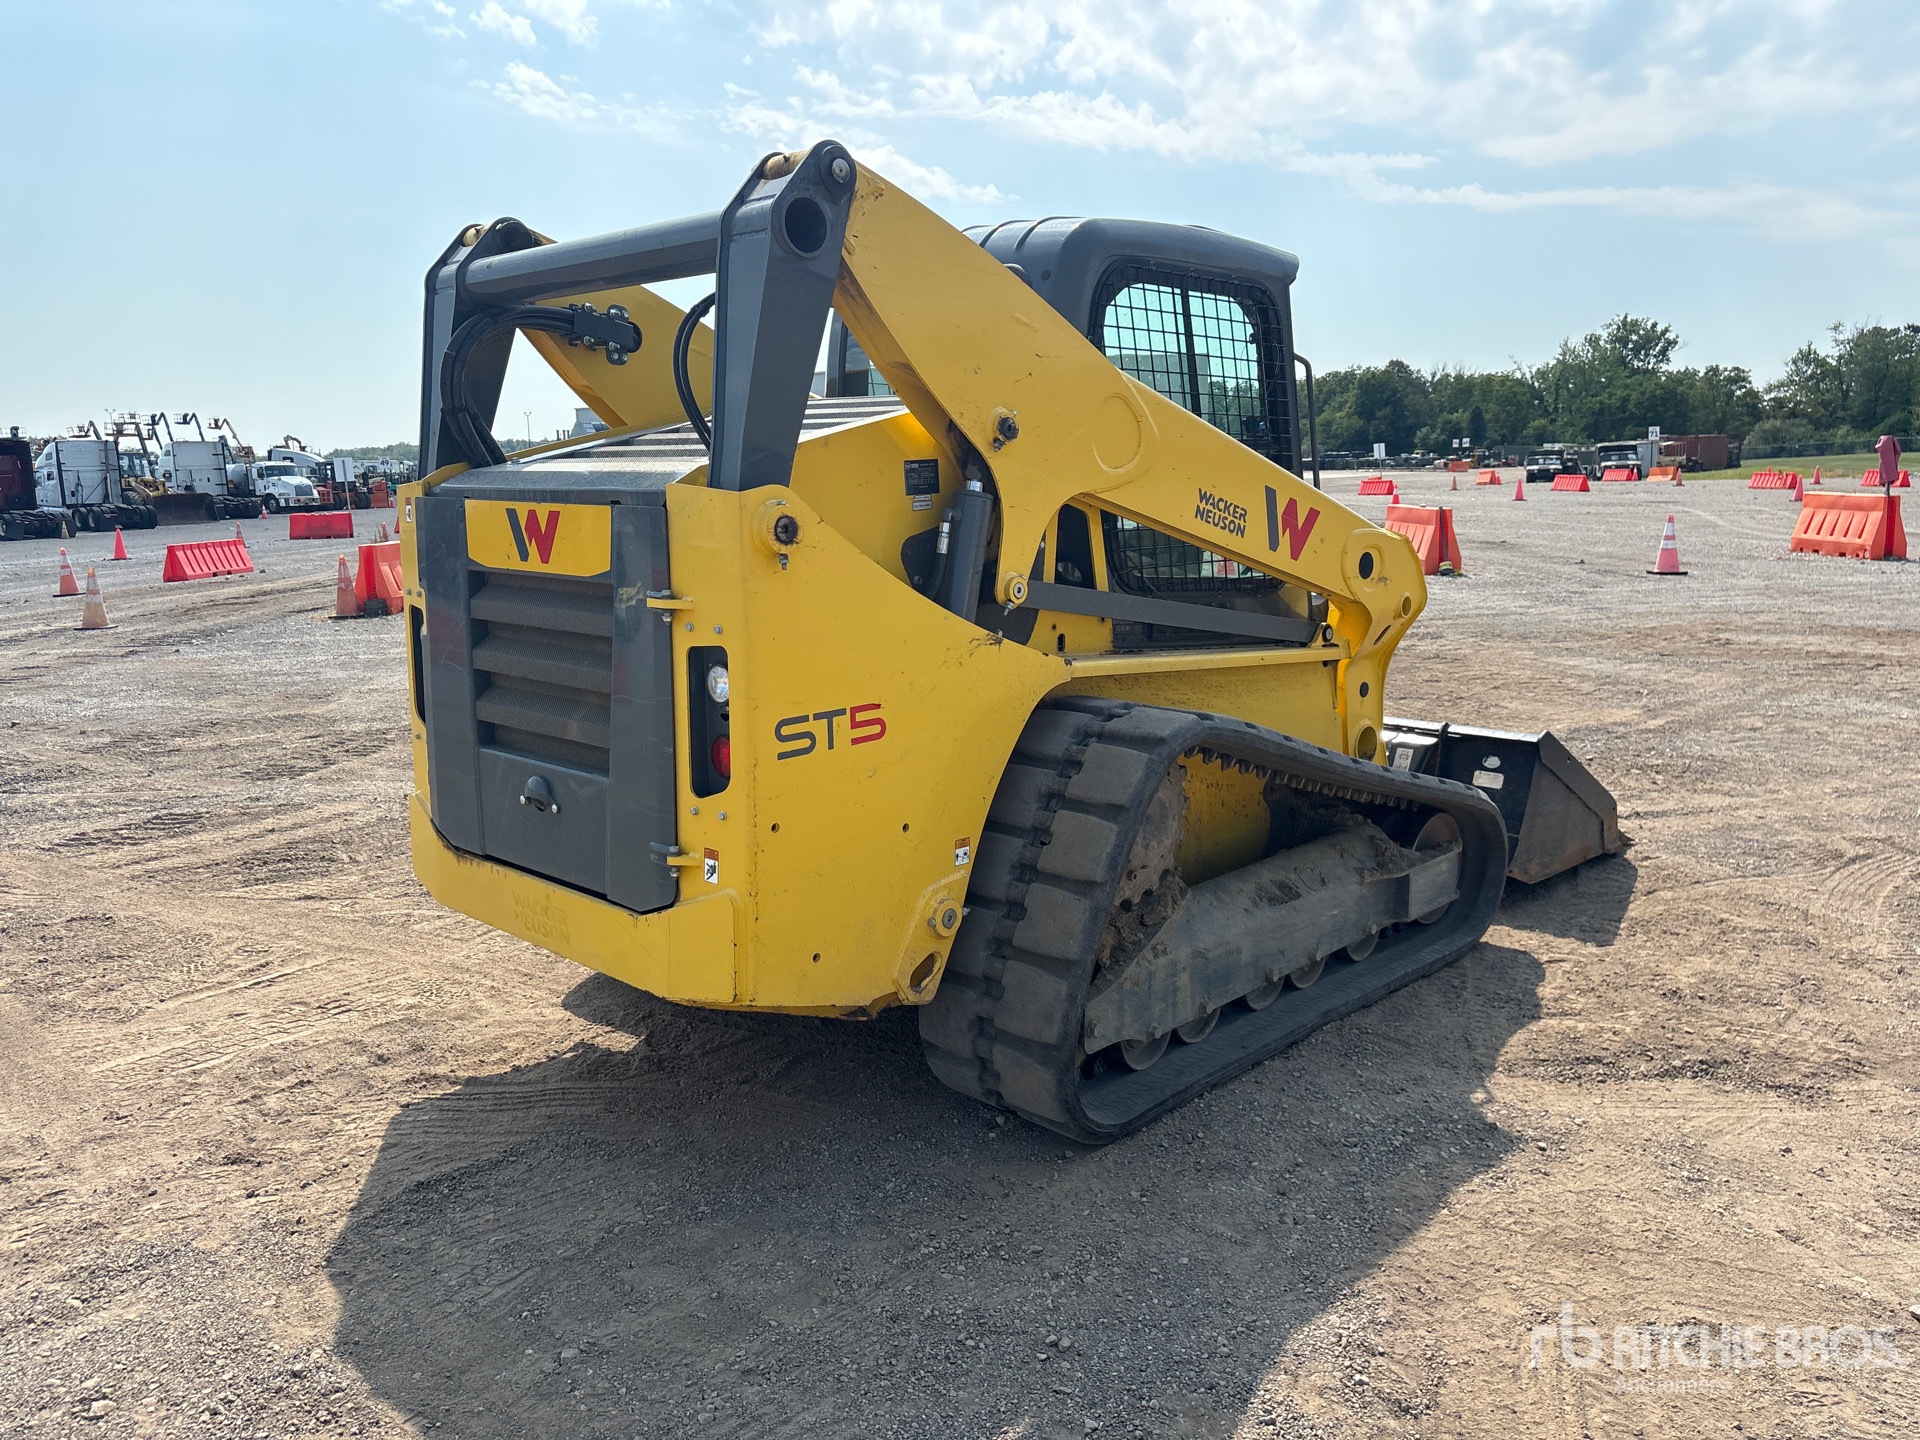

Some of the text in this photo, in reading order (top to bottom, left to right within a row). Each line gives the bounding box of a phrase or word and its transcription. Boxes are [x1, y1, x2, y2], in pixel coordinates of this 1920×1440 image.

[1195, 505, 1246, 538] NEUSON
[1198, 488, 1247, 523] WACKER
[505, 508, 560, 564] W
[775, 703, 886, 760] ST5
